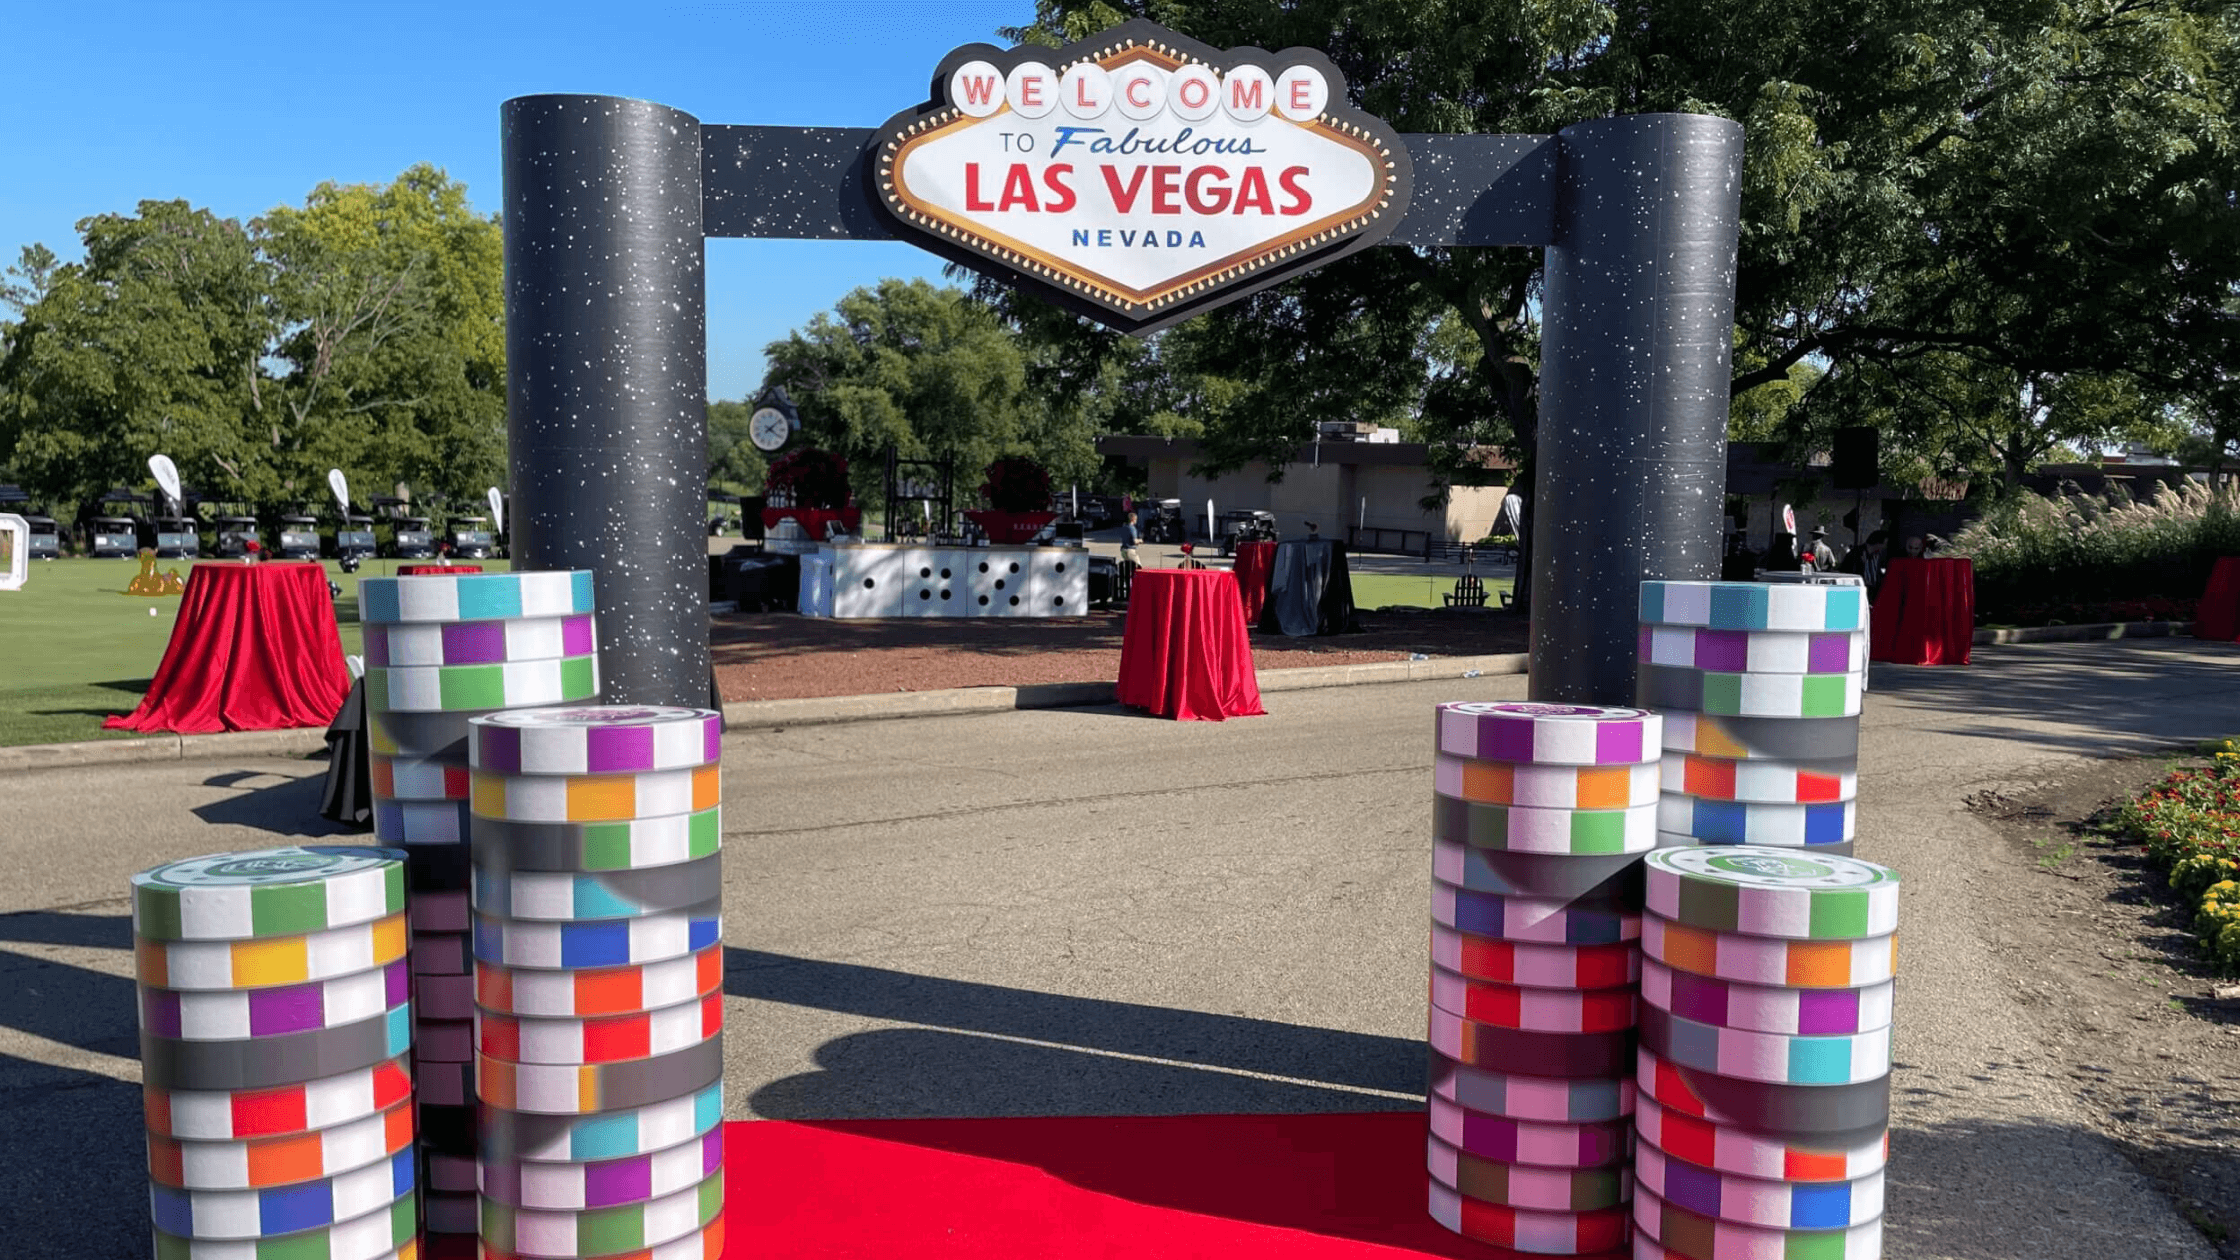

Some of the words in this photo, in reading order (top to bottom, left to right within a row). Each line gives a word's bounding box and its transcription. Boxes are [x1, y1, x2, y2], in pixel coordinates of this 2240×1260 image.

[962, 75, 1313, 110] WELCOME
[999, 132, 1034, 152] TO
[1050, 126, 1266, 159] Fabulous
[965, 162, 1076, 213] LAS
[1100, 164, 1312, 216] VEGAS
[1072, 229, 1206, 248] NEVADA
